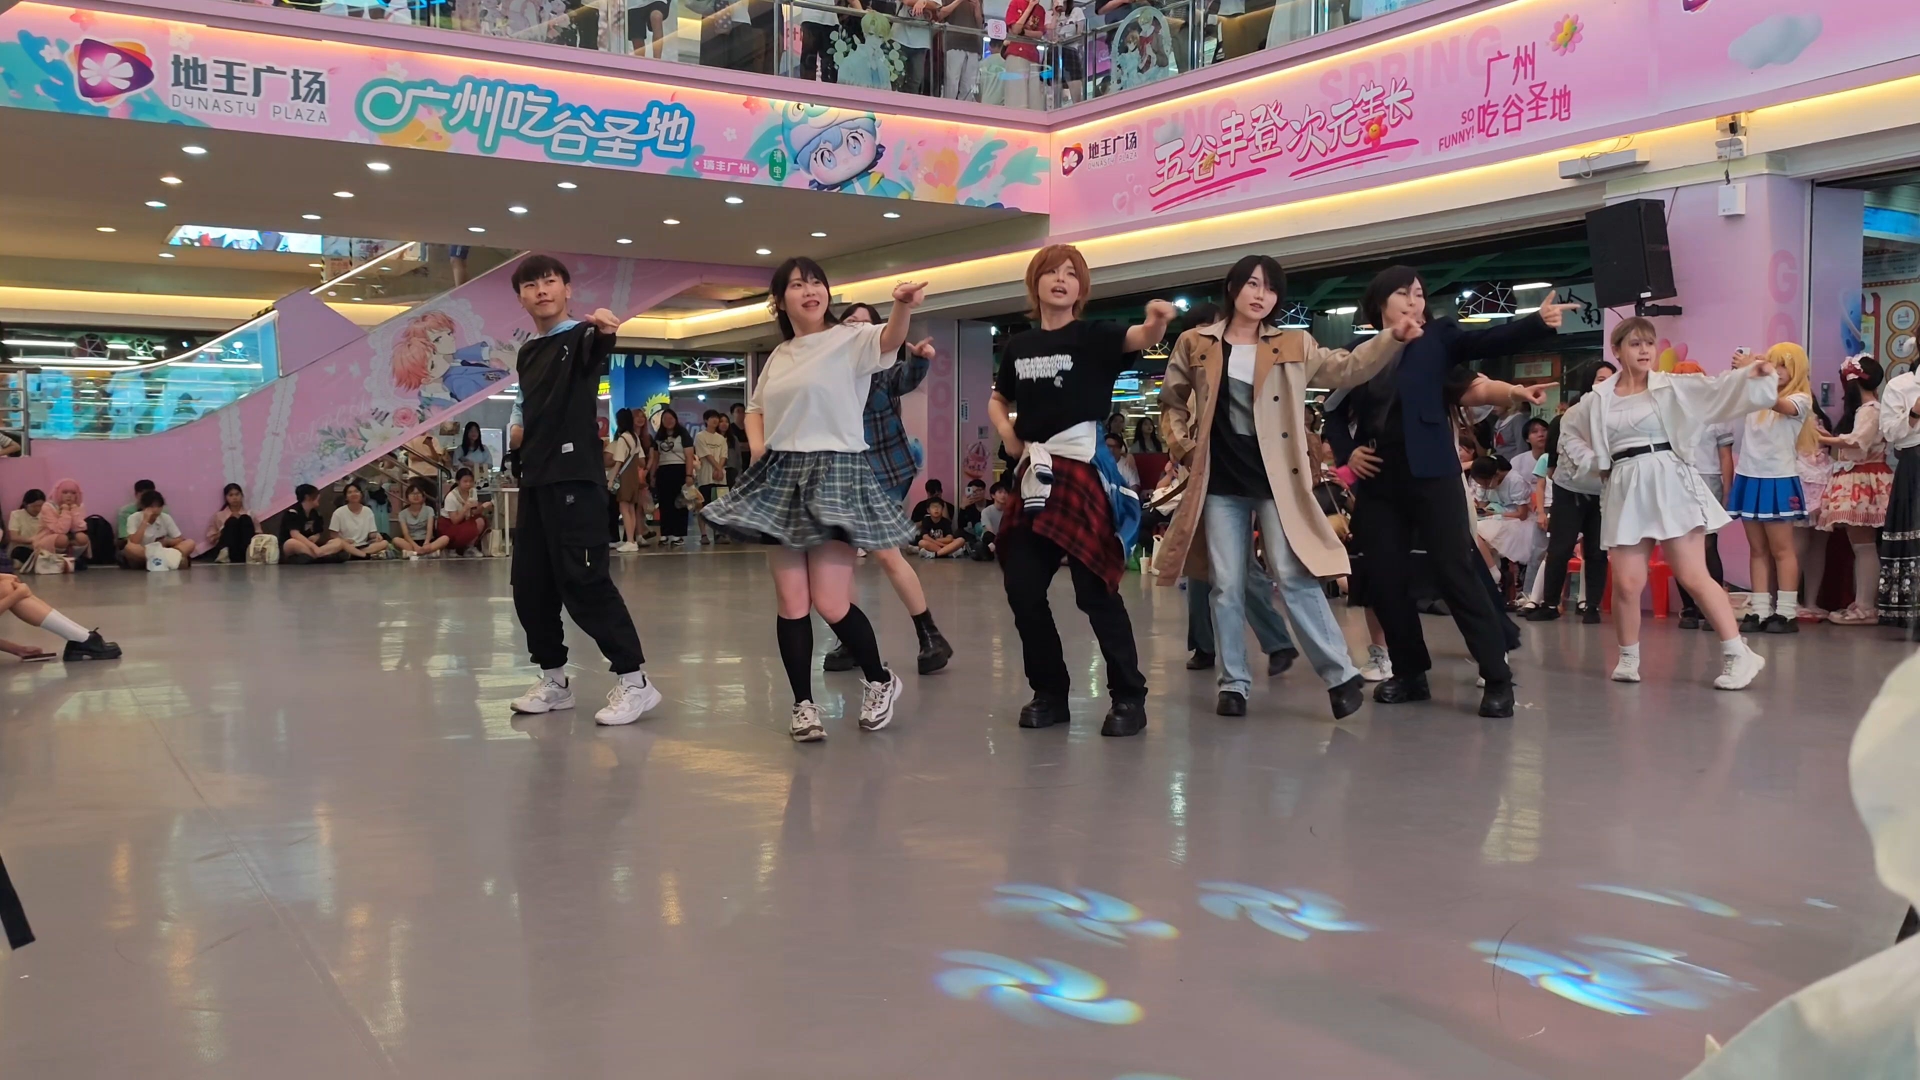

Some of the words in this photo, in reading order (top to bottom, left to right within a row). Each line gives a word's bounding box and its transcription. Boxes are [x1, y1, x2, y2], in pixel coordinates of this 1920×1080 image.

[171, 54, 326, 105] 地王广场
[1484, 41, 1536, 98] 广州
[172, 94, 256, 115] DYNASTY
[273, 105, 327, 123] PLAZA
[361, 81, 690, 161] 广州吃谷圣地
[1461, 108, 1475, 125] SO
[1477, 81, 1571, 137] 吃谷圣地
[1088, 131, 1137, 160] 地王广场
[1438, 125, 1475, 151] FUNNY!
